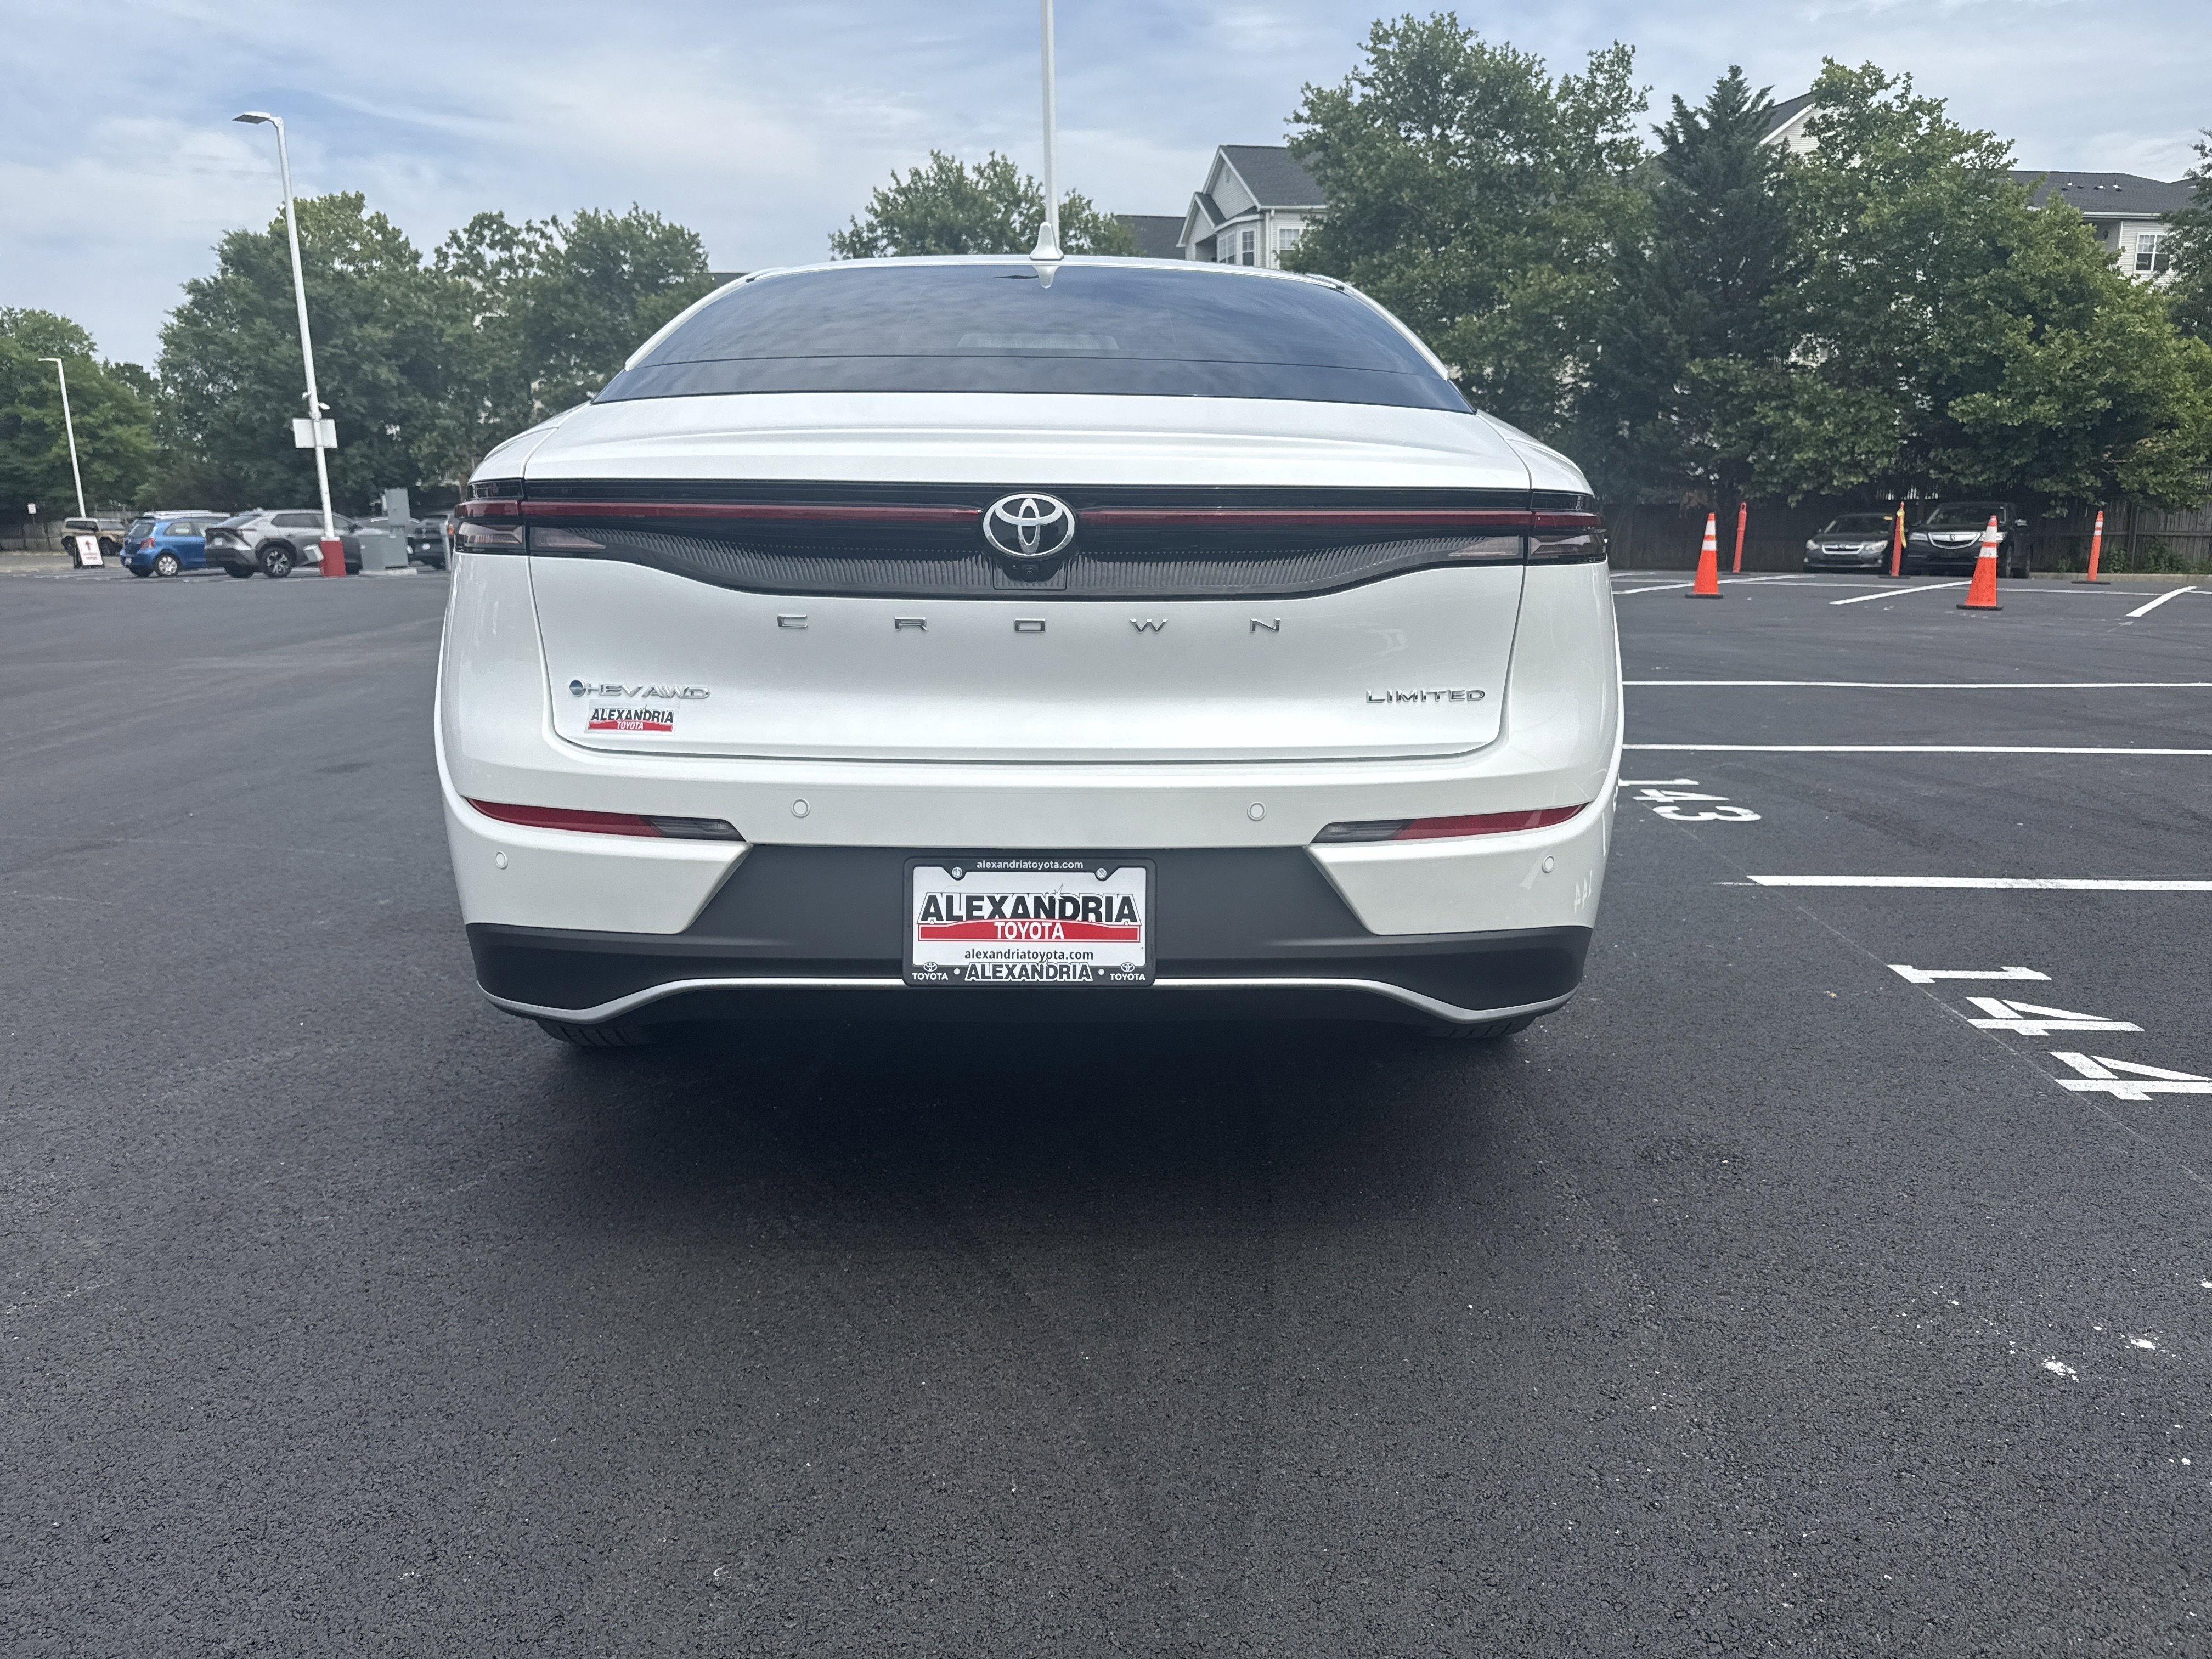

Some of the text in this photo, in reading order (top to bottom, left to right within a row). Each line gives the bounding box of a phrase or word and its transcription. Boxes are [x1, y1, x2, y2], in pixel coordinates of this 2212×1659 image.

[777, 614, 1282, 633] CROWN
[1366, 689, 1486, 703] LIMITED
[591, 708, 674, 724] ALEXANDRIA
[617, 721, 644, 730] TOYOTA
[977, 860, 1084, 871] alexandriatoyota.com
[918, 893, 1141, 924] ALEXANDRIA
[994, 921, 1065, 940] TOYOTA
[964, 949, 1094, 962] alexandriatoyota.com
[912, 973, 949, 981] TOYOTA
[965, 962, 1093, 981] ALEXANDRIA
[1109, 973, 1146, 981] TOYOTA
[1887, 964, 2212, 1101] 144
